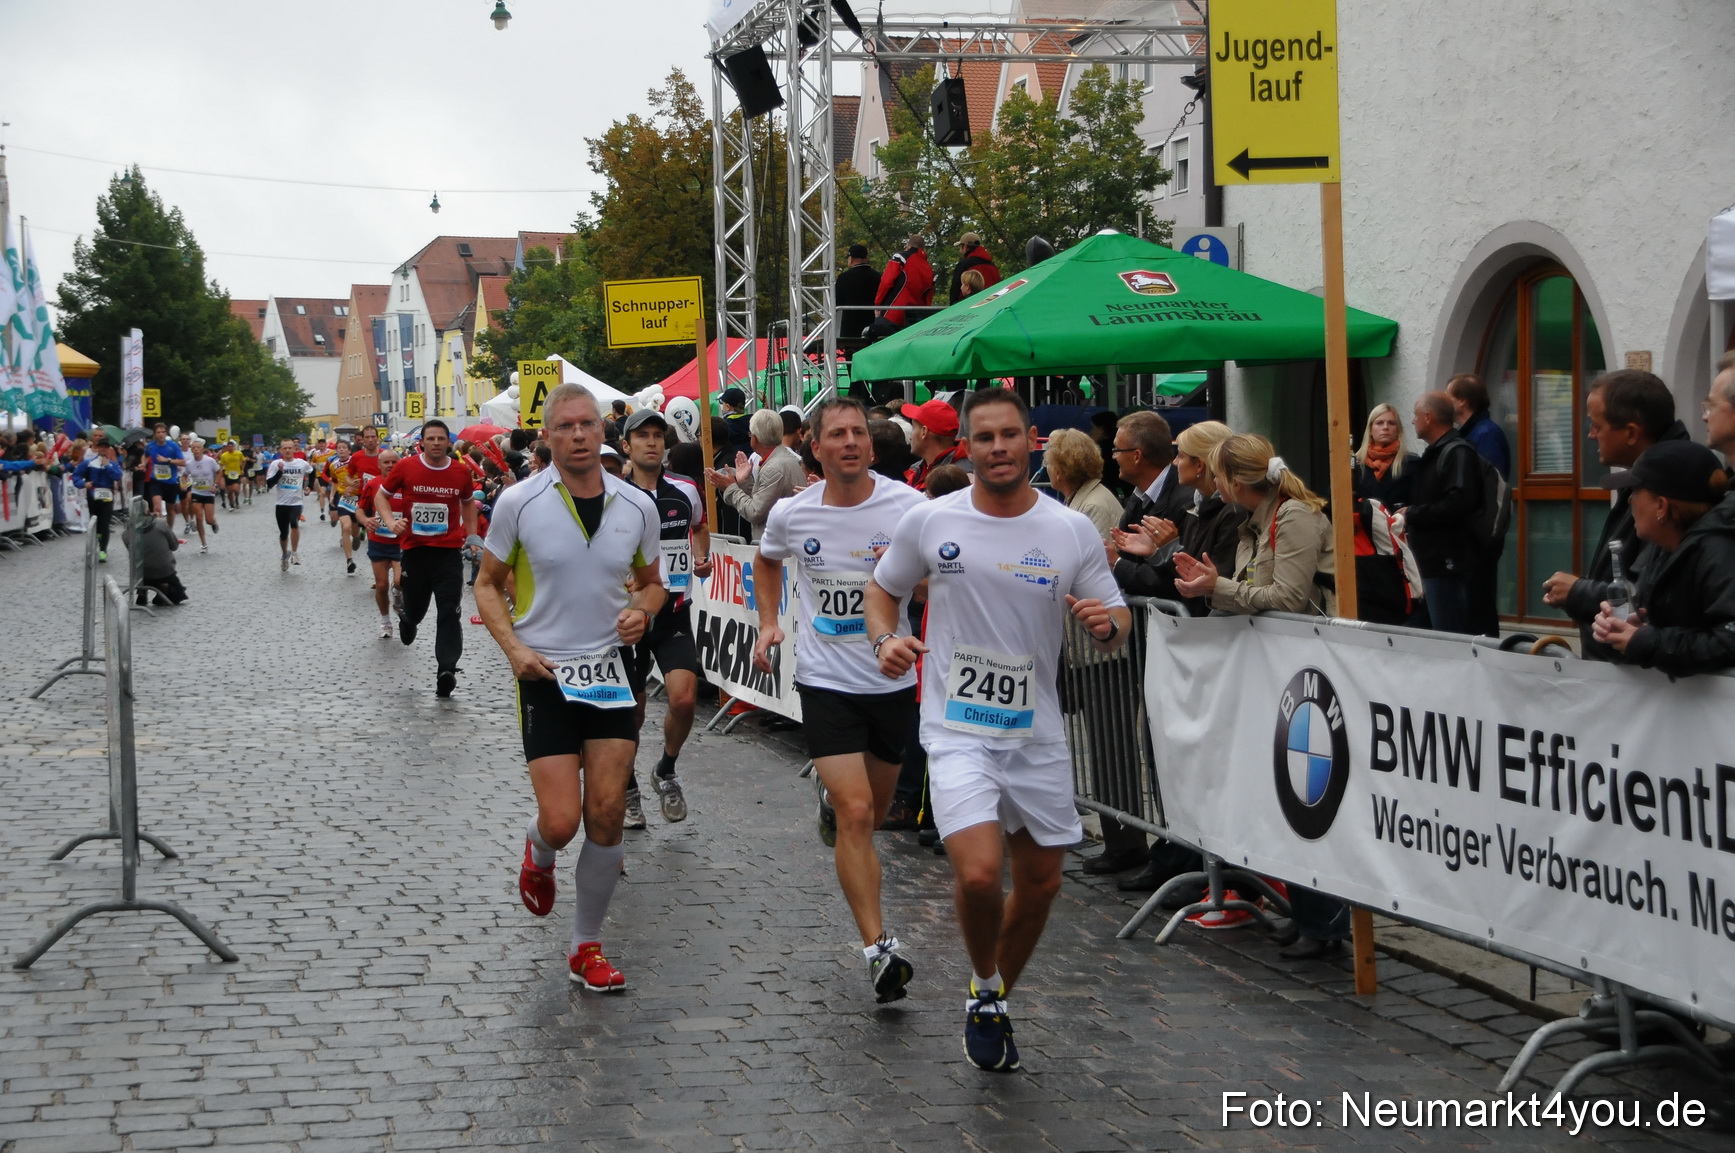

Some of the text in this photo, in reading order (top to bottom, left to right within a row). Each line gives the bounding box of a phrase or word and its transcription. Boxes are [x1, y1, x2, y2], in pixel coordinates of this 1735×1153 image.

[1215, 30, 1333, 70] Jugend-
[1249, 70, 1303, 102] lauf
[611, 298, 695, 314] Schnupper-
[1105, 300, 1230, 313] Neumarkter
[641, 316, 668, 330] lauf
[1088, 310, 1263, 327] Lammsbräu
[523, 363, 558, 376] Block
[146, 397, 156, 411] B
[529, 380, 549, 414] A
[411, 400, 421, 414] B
[413, 485, 454, 495] NEUMARKT
[415, 510, 445, 523] 2379
[811, 577, 834, 586] PARTL
[835, 622, 864, 634] Deniz
[953, 651, 984, 665] PARTL
[560, 661, 621, 687] 2934
[956, 666, 1028, 706] 2491
[964, 707, 1018, 727] Christian
[1368, 700, 1483, 793] BMW
[1370, 793, 1491, 872] Weniger
[1495, 822, 1678, 922] Verbrauch.
